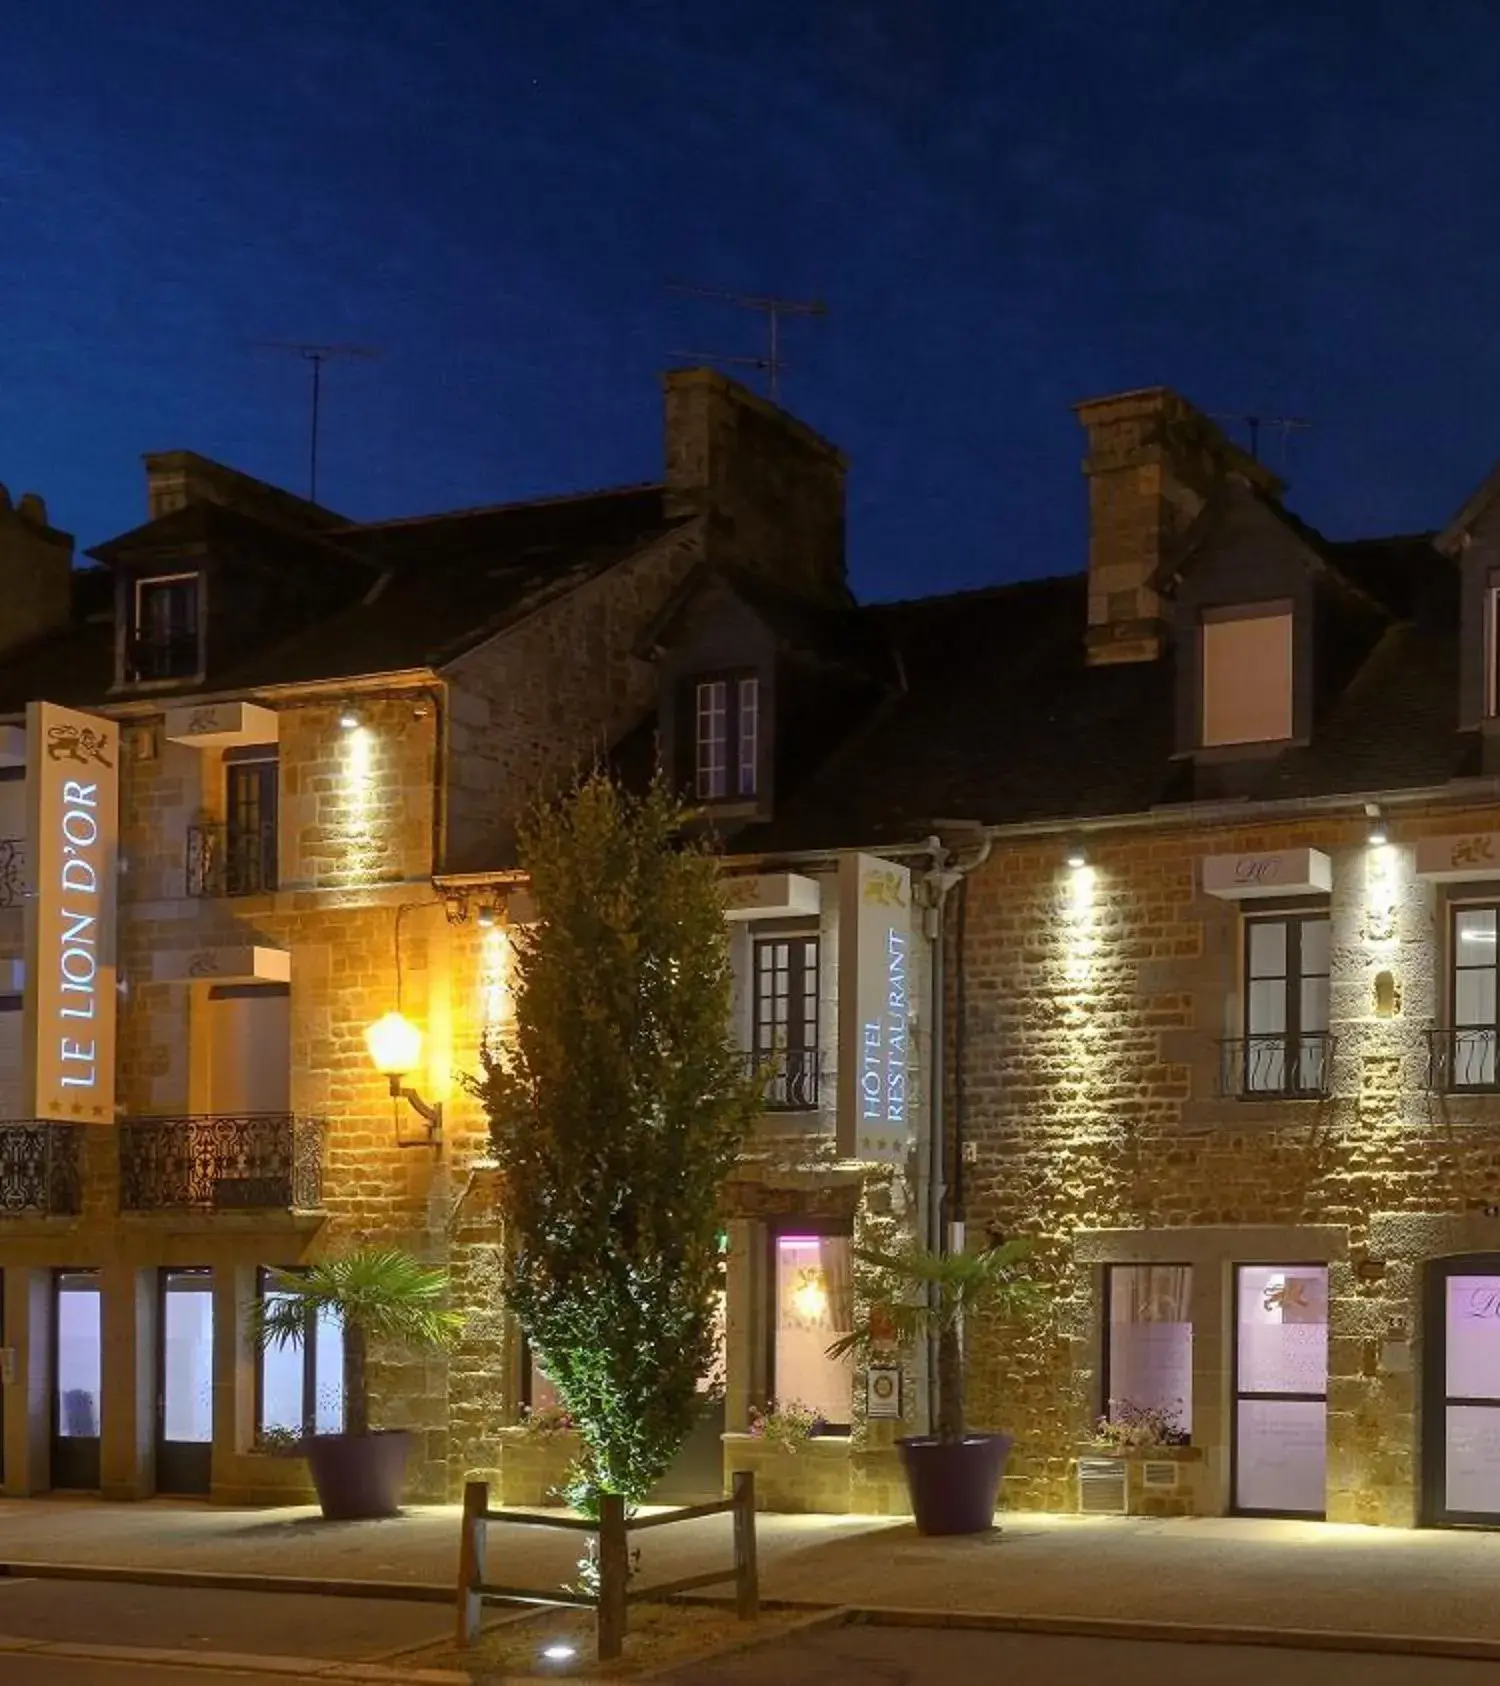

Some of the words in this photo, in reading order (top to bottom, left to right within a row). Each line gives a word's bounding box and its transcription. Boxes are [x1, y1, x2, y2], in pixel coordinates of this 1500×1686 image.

[61, 907, 97, 1019] LION
[61, 1036, 97, 1088] LE
[887, 927, 905, 1121] RESTAURANT
